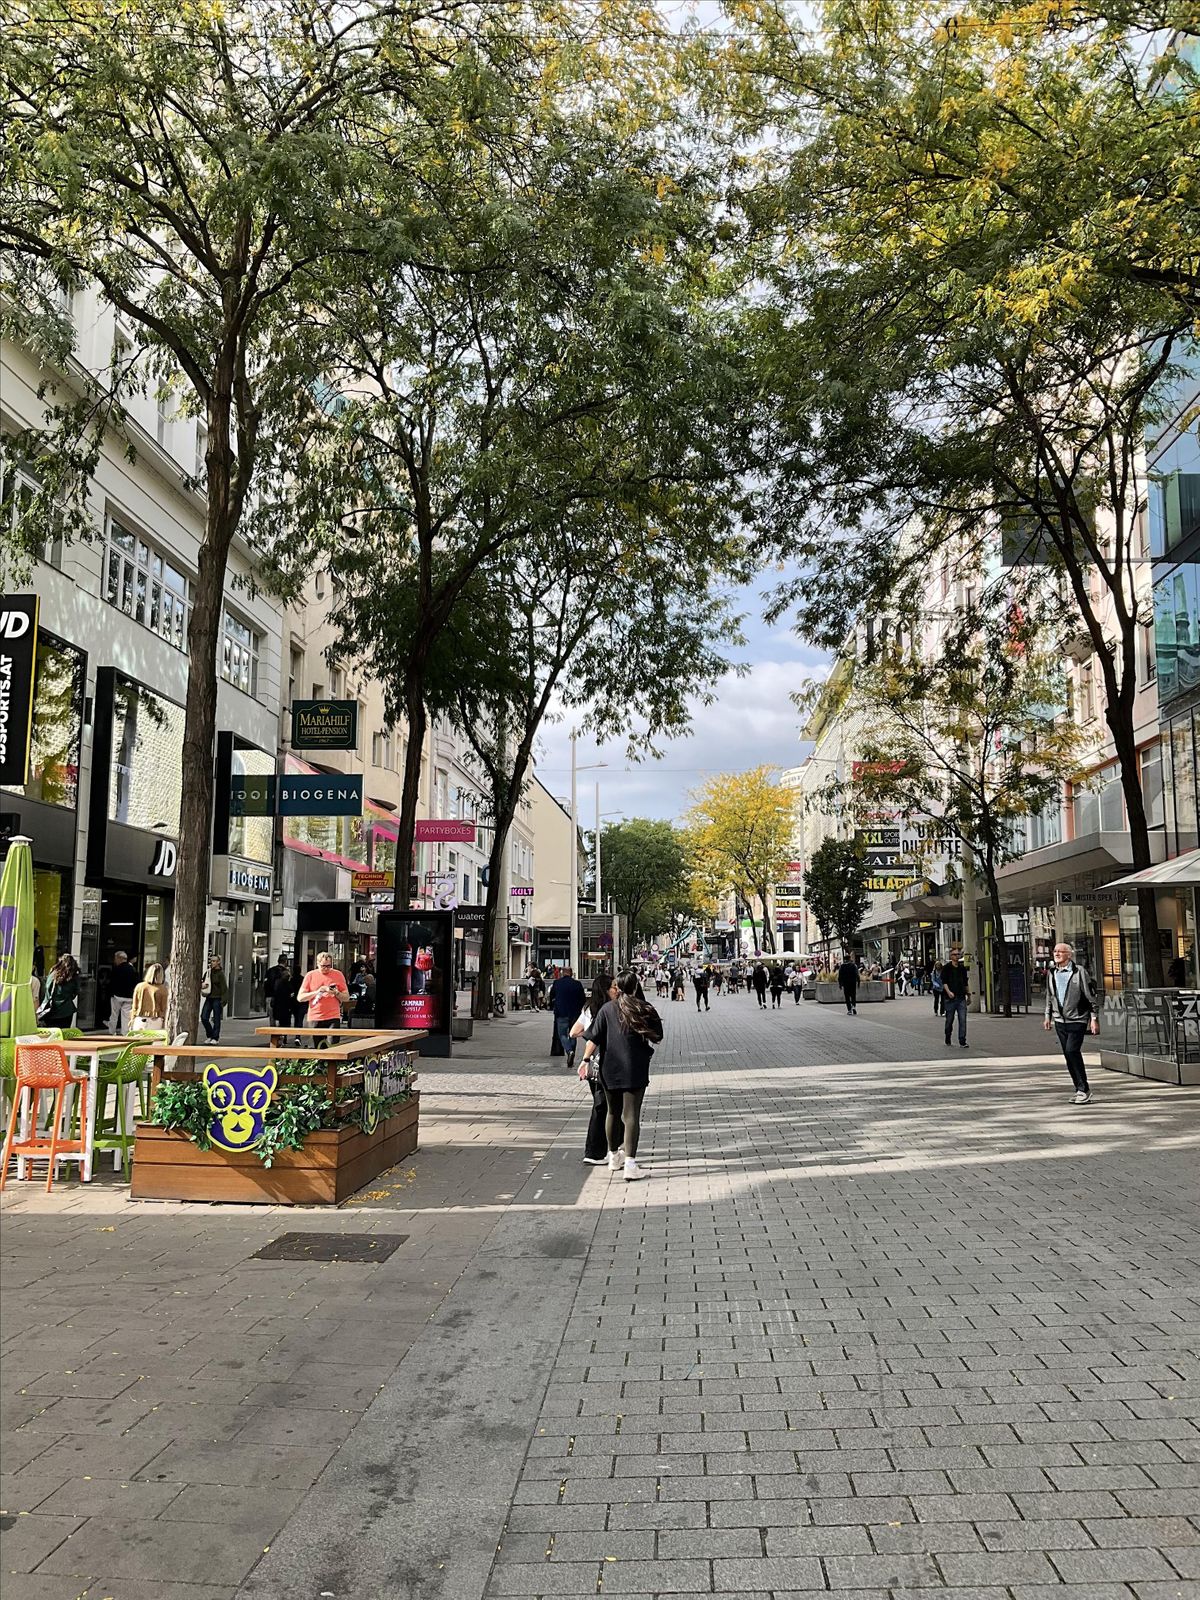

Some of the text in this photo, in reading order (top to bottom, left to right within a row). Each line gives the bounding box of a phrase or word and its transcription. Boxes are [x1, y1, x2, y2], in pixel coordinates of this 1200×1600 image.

[300, 713, 350, 726] MARIAHILF
[282, 790, 359, 800] BIOGENA
[420, 827, 472, 835] PARTYBOXES
[862, 832, 884, 844] XXL
[155, 840, 177, 877] JD
[230, 870, 270, 891] BIOGENA
